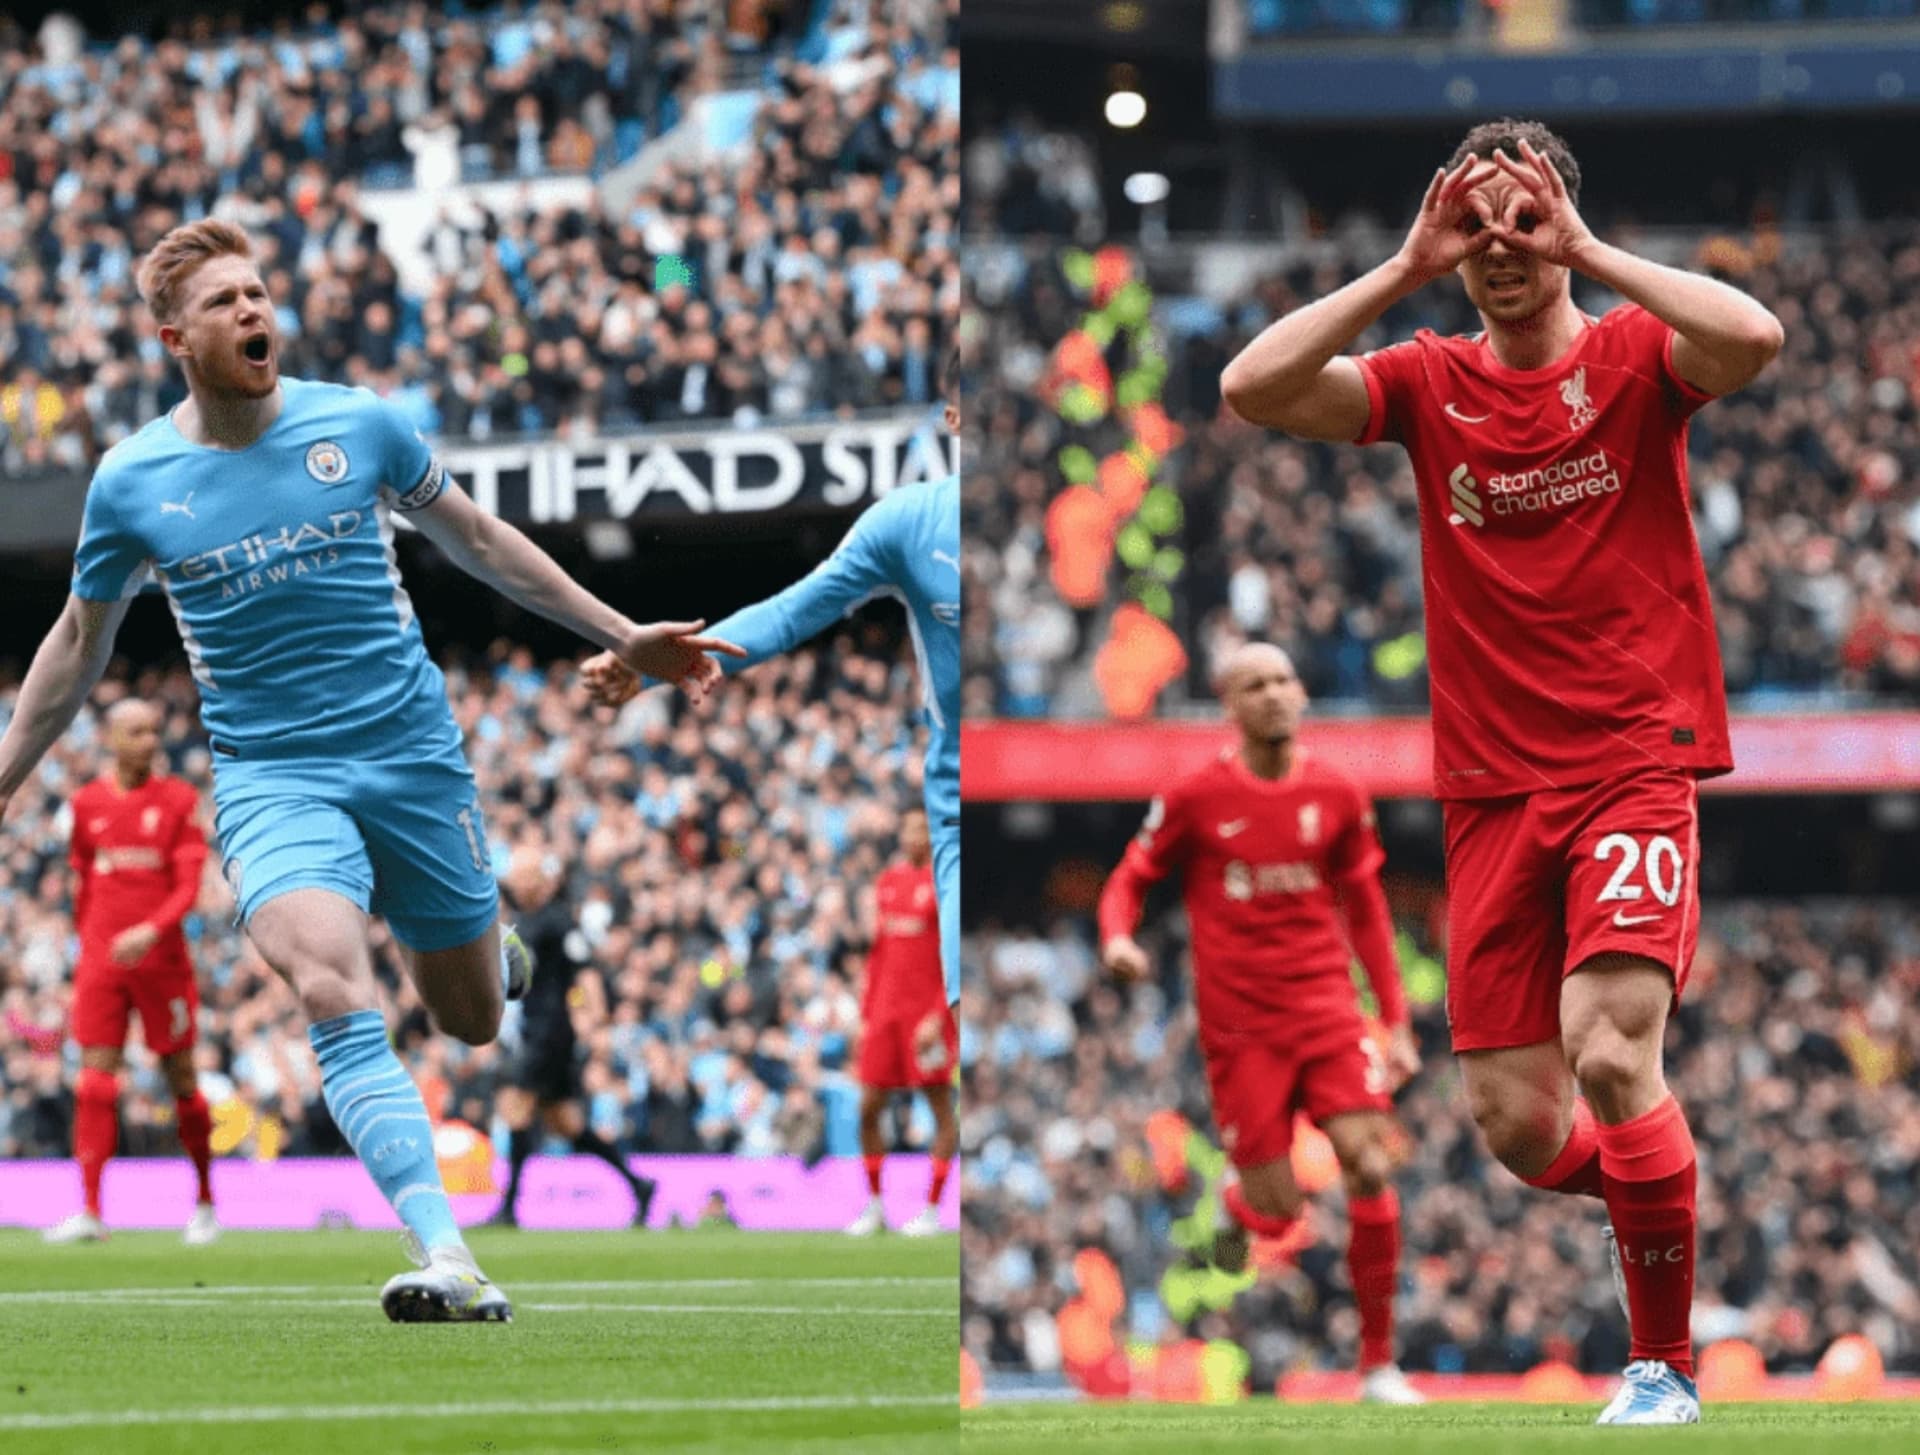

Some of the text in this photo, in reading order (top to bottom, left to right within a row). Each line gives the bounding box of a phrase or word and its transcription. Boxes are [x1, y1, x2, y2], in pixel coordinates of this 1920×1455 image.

[437, 430, 803, 523] TIHAD
[823, 424, 960, 506] STA
[1488, 450, 1608, 495] standard
[1492, 470, 1620, 515] chartered
[182, 510, 362, 580] ETIHAD
[222, 547, 340, 599] AIRWAYS
[1594, 833, 1684, 908] 20
[1623, 1243, 1684, 1267] LFC
